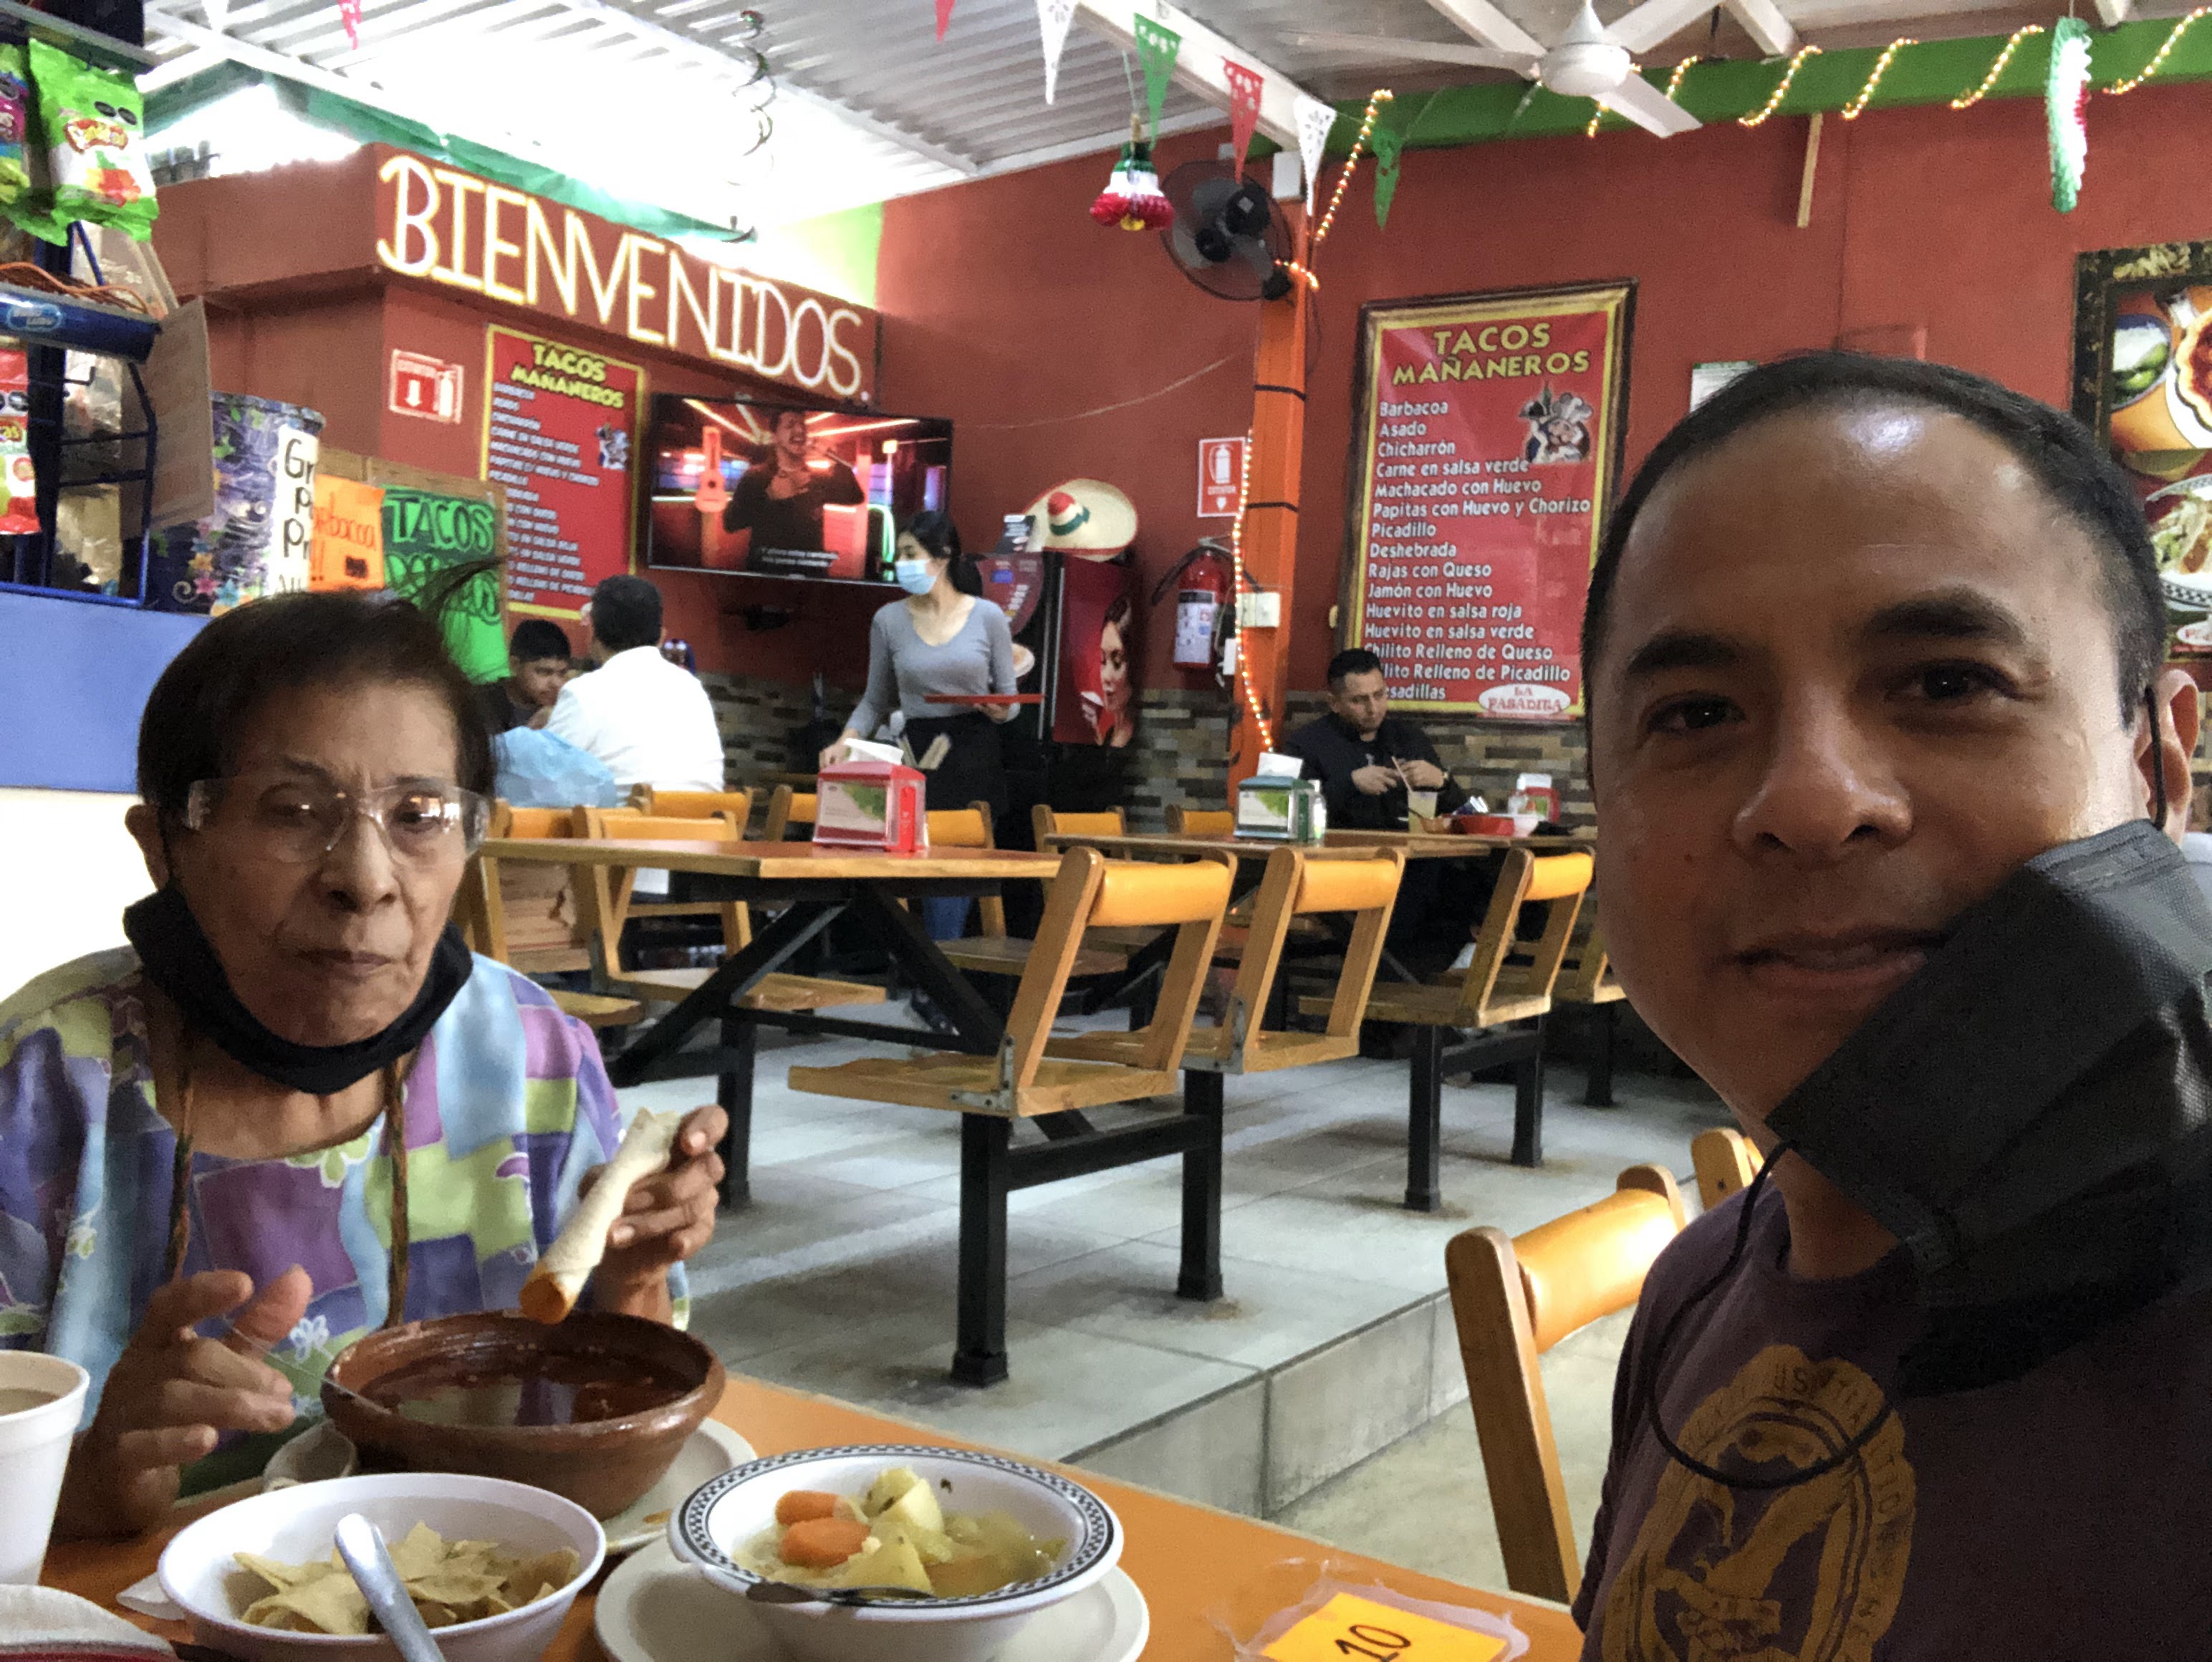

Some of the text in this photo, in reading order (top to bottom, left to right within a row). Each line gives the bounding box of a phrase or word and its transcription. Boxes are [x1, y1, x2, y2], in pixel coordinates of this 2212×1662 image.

[1433, 322, 1551, 357] TACOS
[533, 342, 606, 383] TACOS
[1393, 350, 1590, 385] MAÑANEROS
[1379, 400, 1448, 417] Barbacoa
[1378, 421, 1427, 438] Asado
[1377, 439, 1456, 458] Chicharrón
[1376, 456, 1529, 478] Carne en salsa verde
[1375, 478, 1542, 498] Machacado con Huevo
[1372, 496, 1591, 520] Papitas con Huevo y Chorizo
[384, 496, 495, 554] TACOS
[1371, 521, 1437, 538] Picadillo
[1370, 542, 1457, 559] Deshebrada
[1368, 561, 1492, 580] Rajas con Queso
[1367, 582, 1493, 599] Jamón con Huevo
[1366, 602, 1523, 622] Huevito en salsa roja
[1365, 623, 1534, 640] Huevito en salsa verde
[1415, 643, 1473, 660] Relleno
[1476, 644, 1496, 659] de
[1501, 643, 1553, 661] Queso
[1413, 663, 1471, 680] Relleno
[1475, 665, 1496, 680] de
[1501, 665, 1571, 682] Picadillo
[1335, 1623, 1411, 1662] 10
